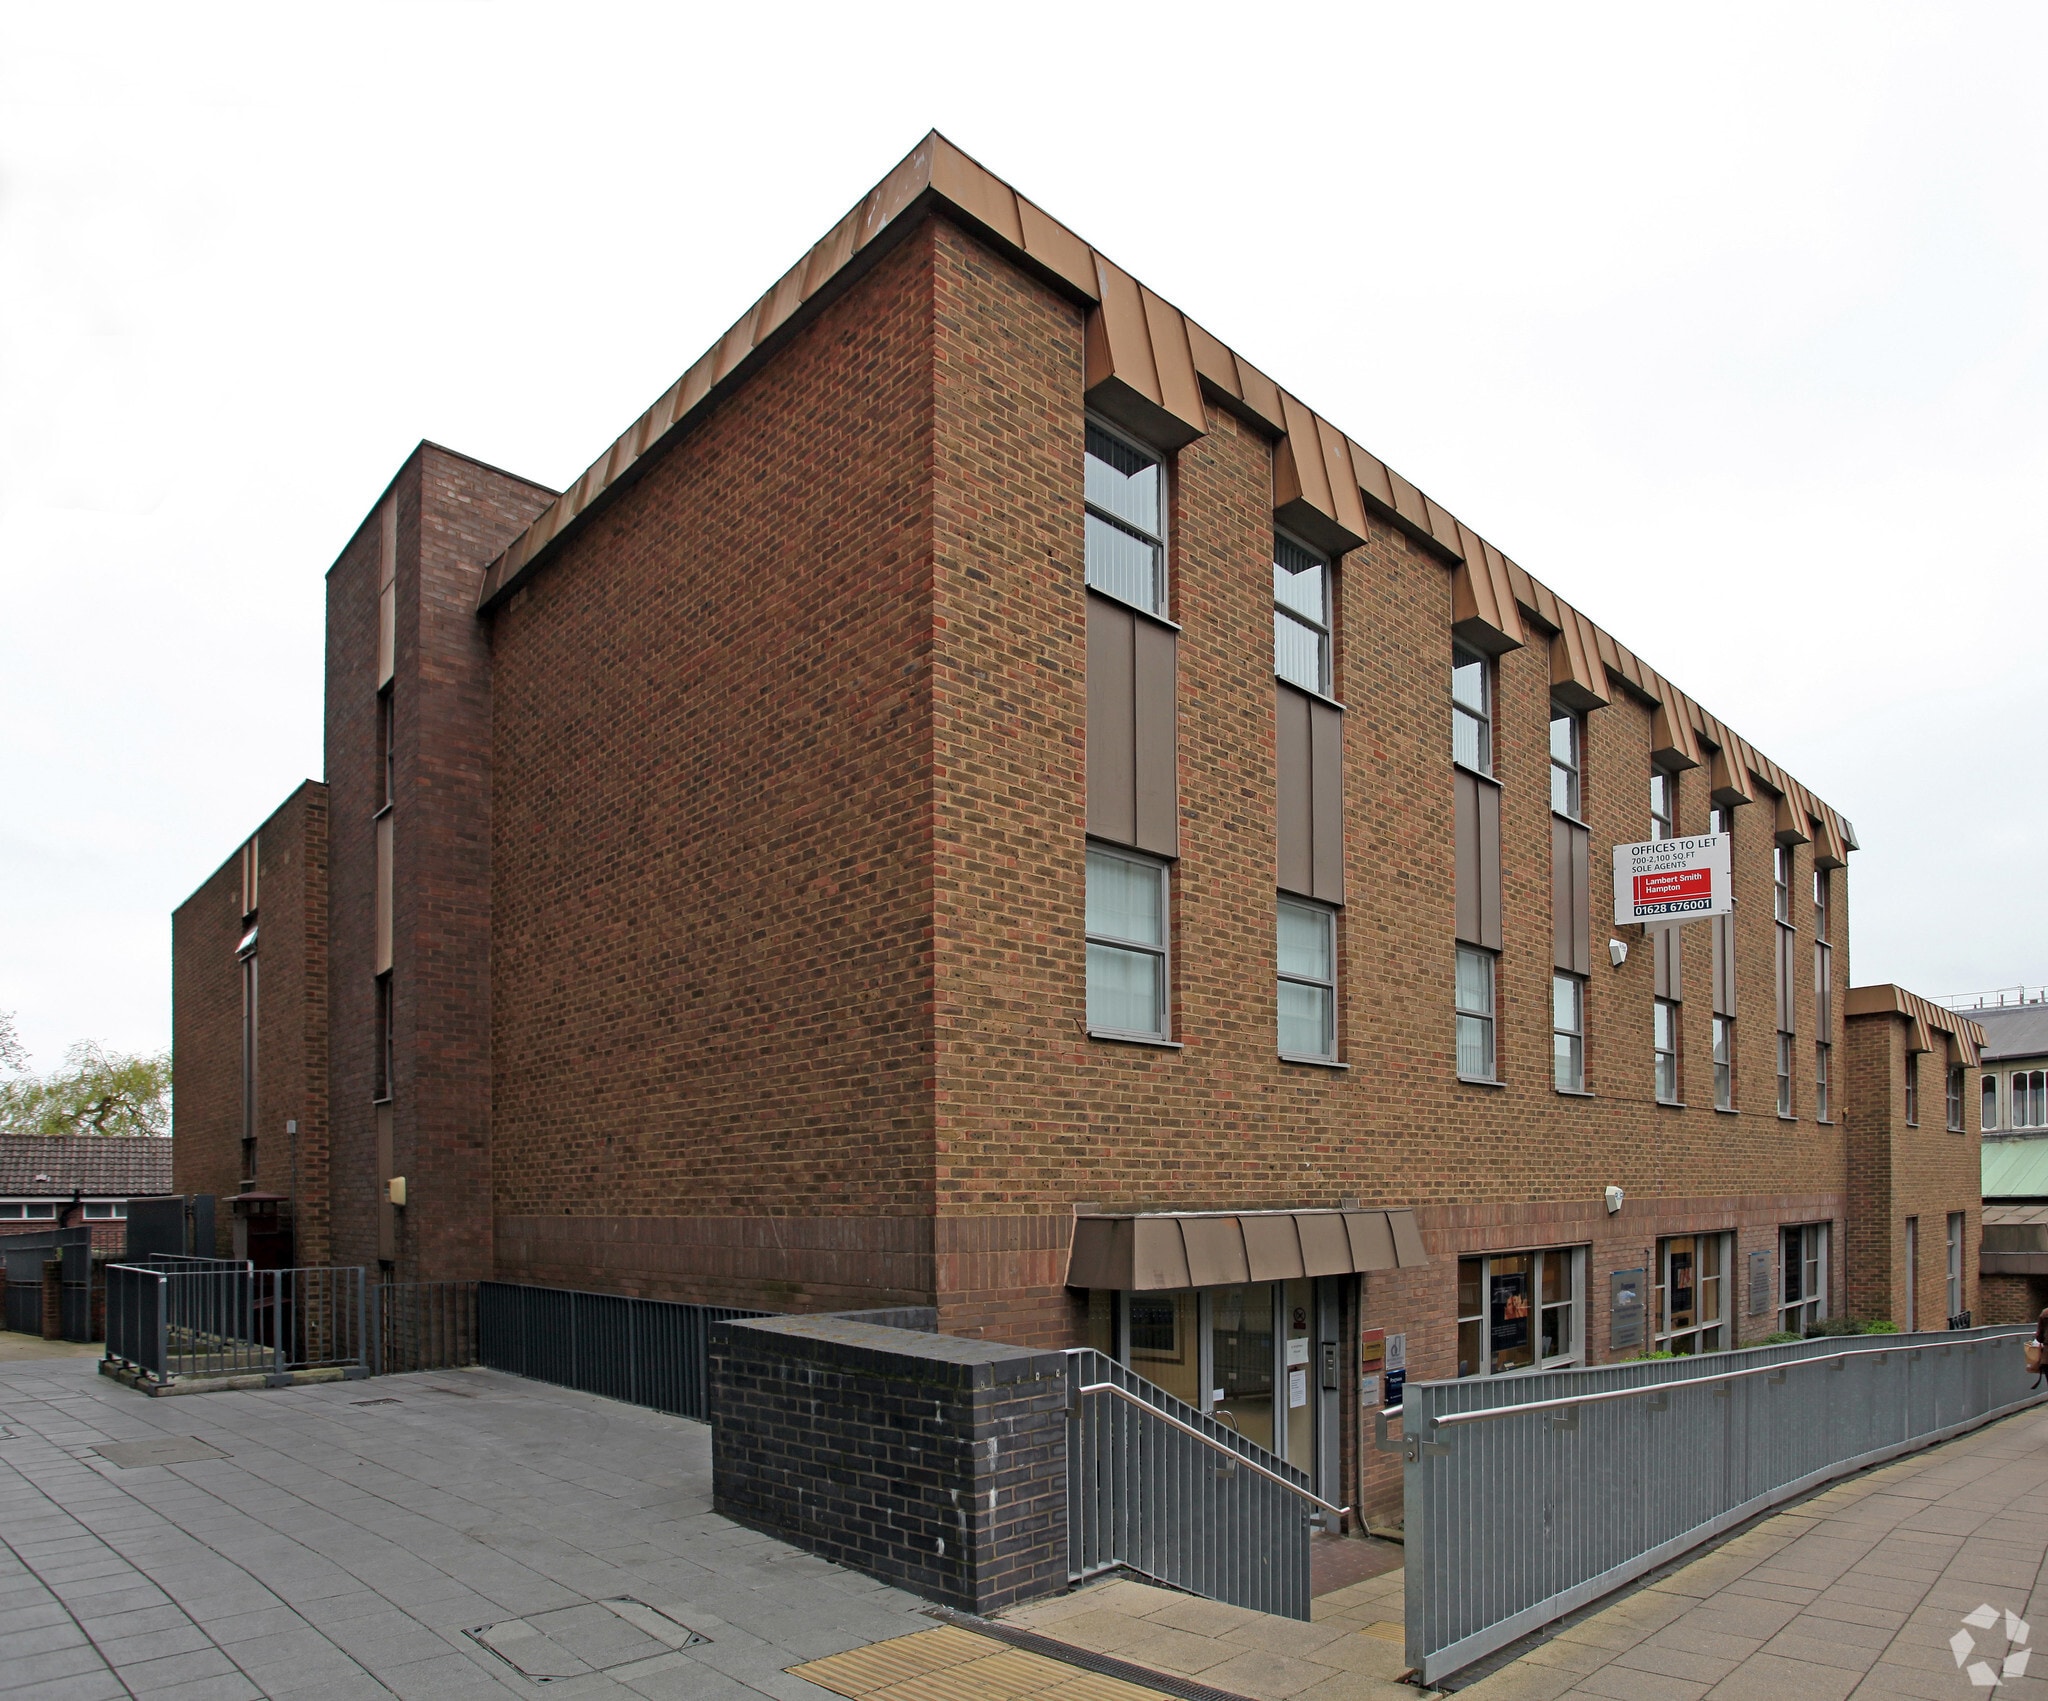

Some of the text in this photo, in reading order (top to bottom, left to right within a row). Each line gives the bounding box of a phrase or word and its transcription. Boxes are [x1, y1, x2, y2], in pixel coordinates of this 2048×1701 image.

[1631, 838, 1717, 856] OFFICES TO LET
[1632, 854, 1670, 865] 700-2,100
[1632, 861, 1687, 873] SOLE AGENTS
[1645, 873, 1702, 886] Lambert Smith
[1645, 884, 1681, 894] Hampton
[1635, 899, 1710, 915] 01628 676001
